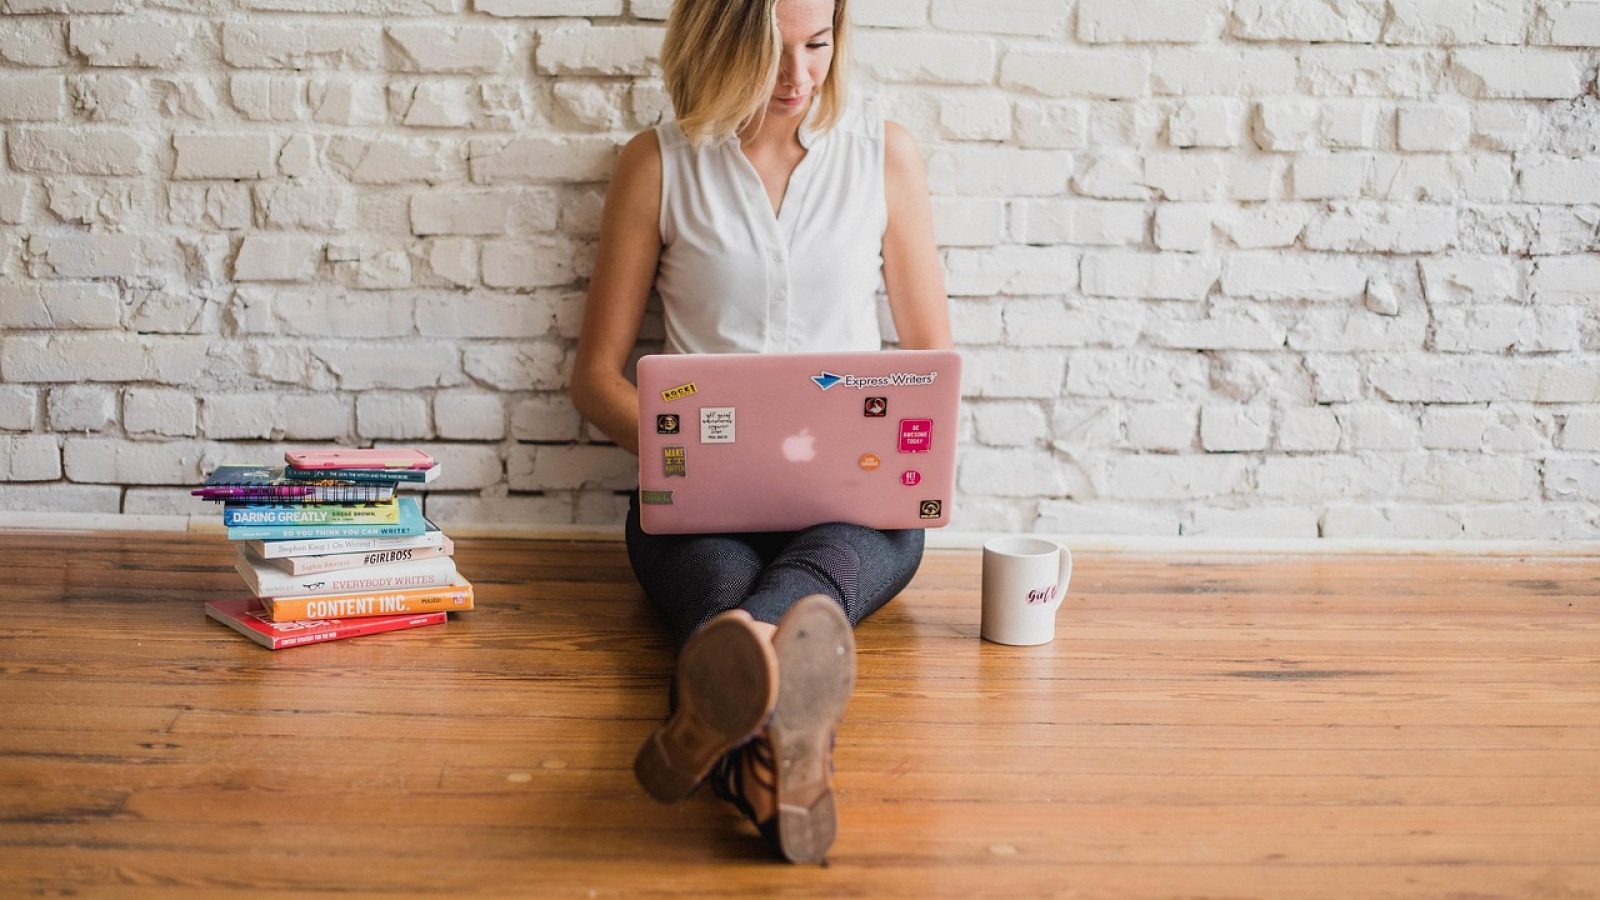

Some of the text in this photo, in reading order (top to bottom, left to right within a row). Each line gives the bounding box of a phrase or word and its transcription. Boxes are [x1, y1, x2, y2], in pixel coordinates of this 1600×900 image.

[845, 374, 932, 388] Express Writers
[664, 448, 685, 457] MAKE
[233, 511, 328, 522] DARING GREATLY
[278, 544, 306, 553] Stephen
[307, 543, 326, 552] King
[345, 540, 371, 549] Writing
[363, 549, 413, 565] #GIRLBOSS
[332, 575, 435, 590] EVERYBODY WRITES
[1028, 586, 1051, 603] Girl
[307, 594, 411, 618] CONTENT INC.
